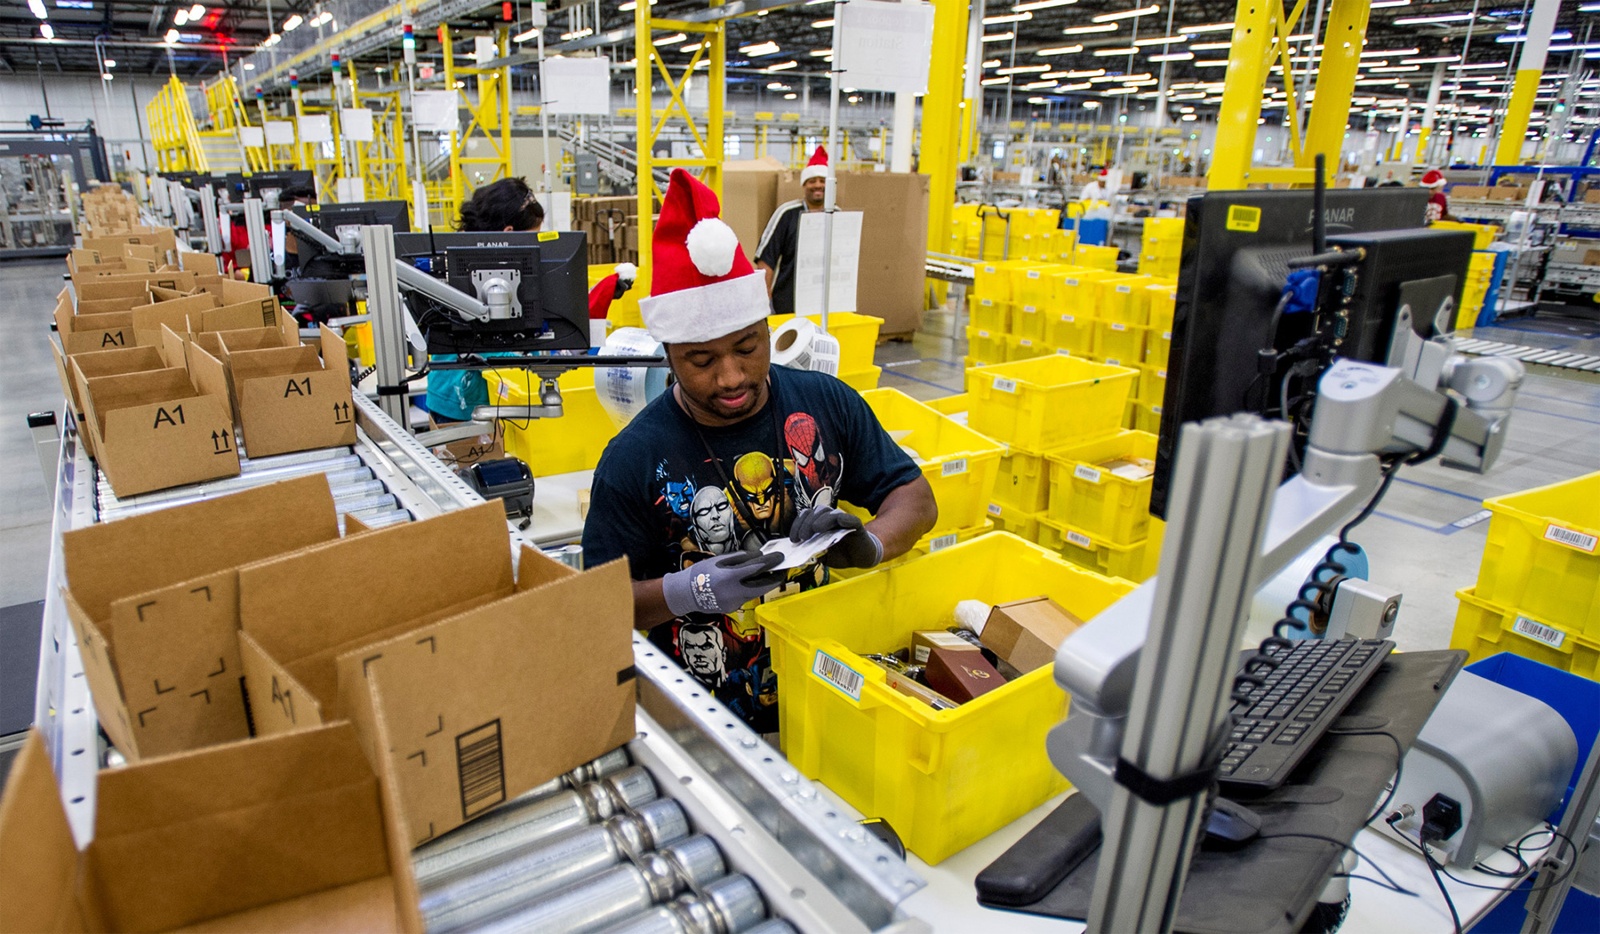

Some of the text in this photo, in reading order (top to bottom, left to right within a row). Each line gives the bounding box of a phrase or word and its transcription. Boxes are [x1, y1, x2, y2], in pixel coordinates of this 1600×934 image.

[1308, 208, 1355, 224] PANAR
[102, 330, 125, 347] A1
[284, 376, 313, 398] A1
[153, 404, 186, 430] A1
[468, 445, 485, 457] A1
[271, 675, 296, 724] A1
